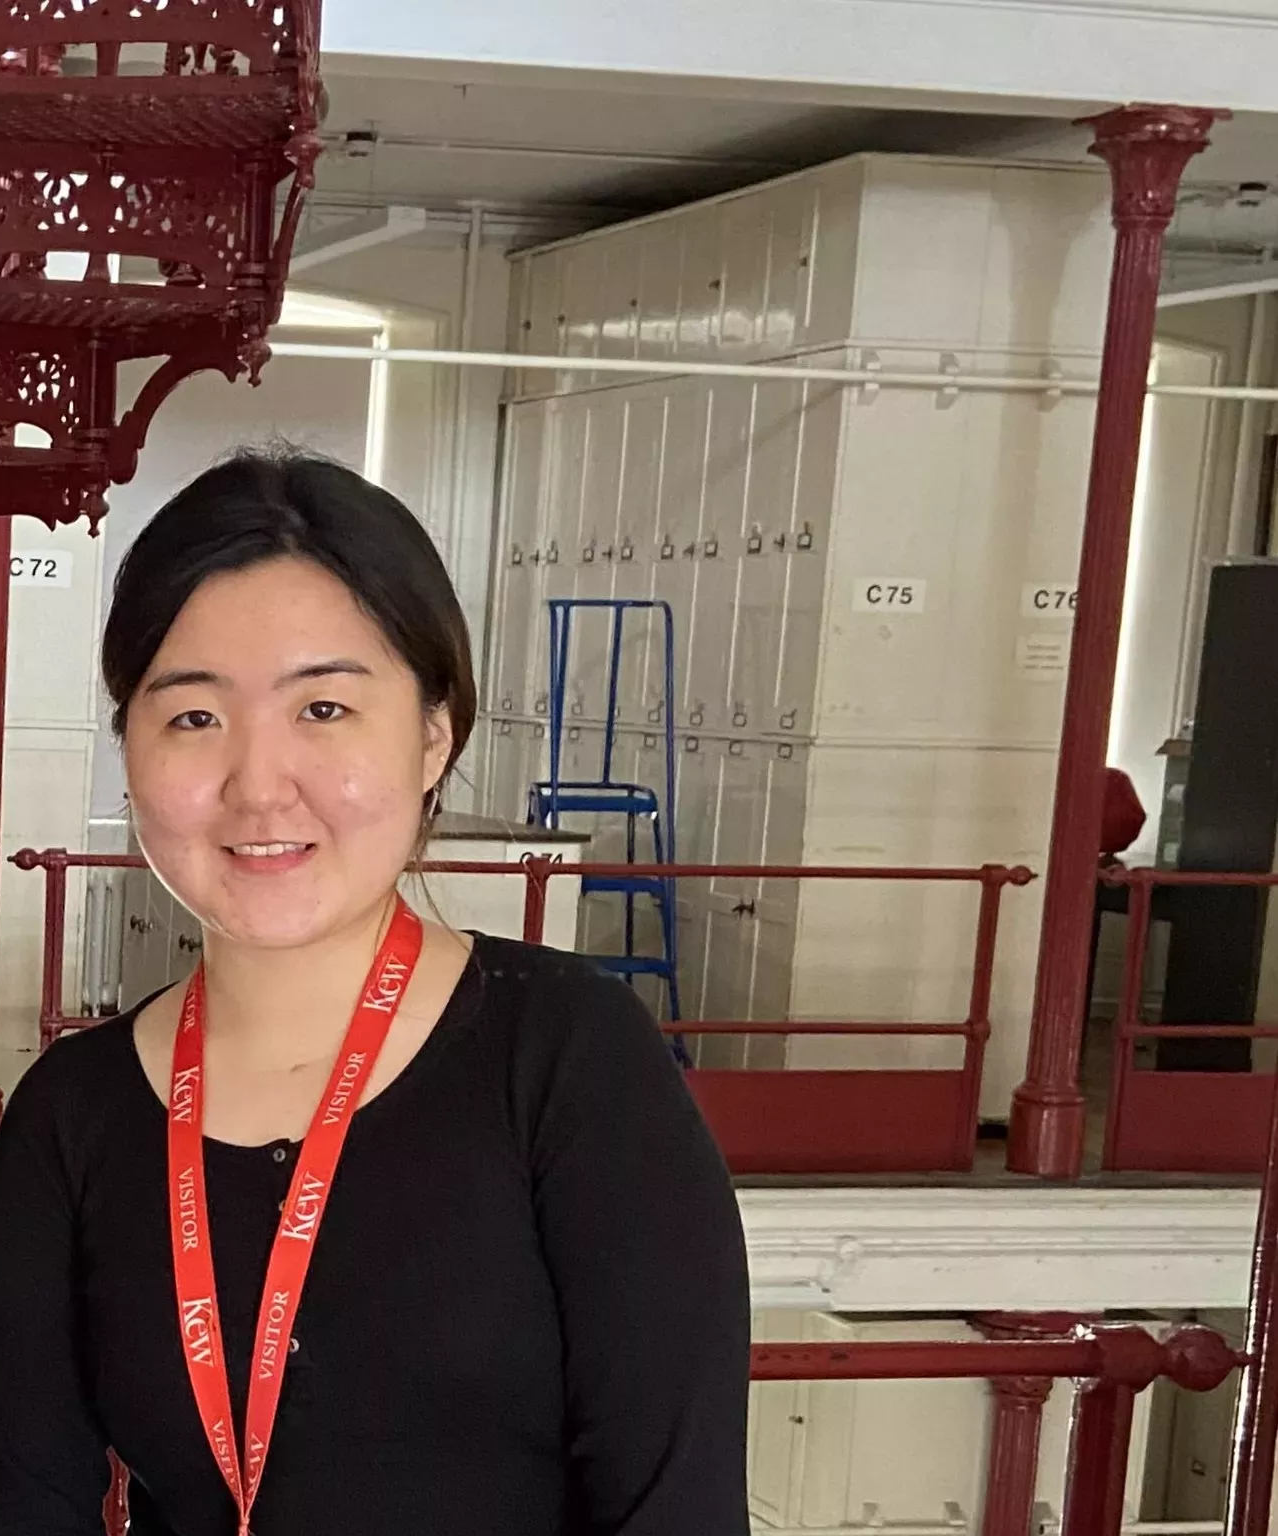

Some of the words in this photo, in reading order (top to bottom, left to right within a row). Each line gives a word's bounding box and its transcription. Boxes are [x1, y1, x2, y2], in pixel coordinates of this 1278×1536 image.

[9, 557, 24, 576] C
[30, 558, 57, 577] 72
[363, 952, 413, 1014] Kew
[170, 1064, 202, 1126] Kew
[322, 1051, 367, 1127] VISITOR
[178, 1167, 199, 1252] VISITOR
[281, 1170, 331, 1243] Kew
[182, 1294, 215, 1368] Kew
[258, 1289, 290, 1382] VISITOR
